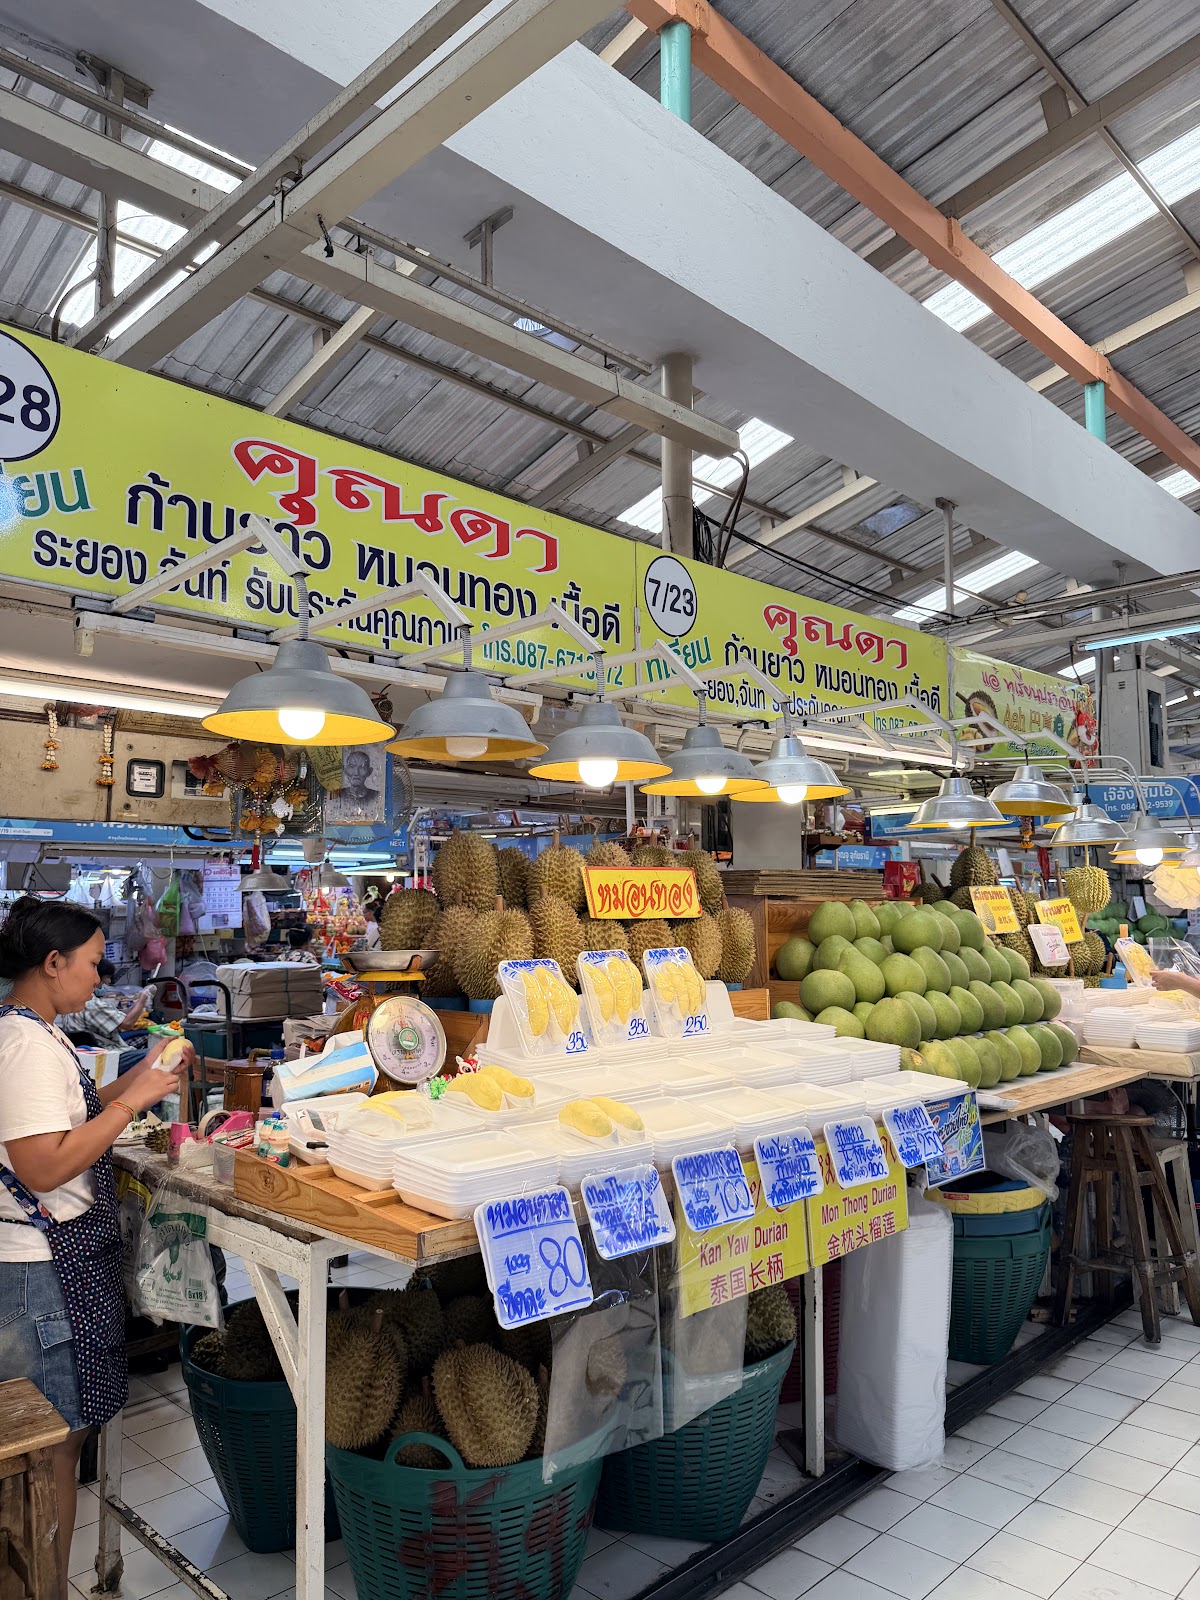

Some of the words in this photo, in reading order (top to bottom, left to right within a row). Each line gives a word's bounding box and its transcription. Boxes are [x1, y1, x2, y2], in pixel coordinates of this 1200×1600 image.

[234, 440, 558, 573] คุณดา
[34, 530, 147, 585] ระยอง
[648, 578, 694, 617] 7/23
[763, 604, 908, 669] คุณดา
[816, 663, 897, 701] หมอนทอง
[1121, 800, 1173, 812] 084-2-9539
[597, 875, 693, 917] หมอนทอง
[821, 1203, 840, 1227] Mon
[843, 1194, 869, 1218] Thong
[872, 1183, 897, 1207] Durian
[700, 1242, 722, 1268] Kan
[727, 1233, 750, 1258] Yaw
[754, 1221, 788, 1249] Durian
[827, 1211, 896, 1260] 金枕头榴莲
[710, 1252, 784, 1306] 泰国长柄
